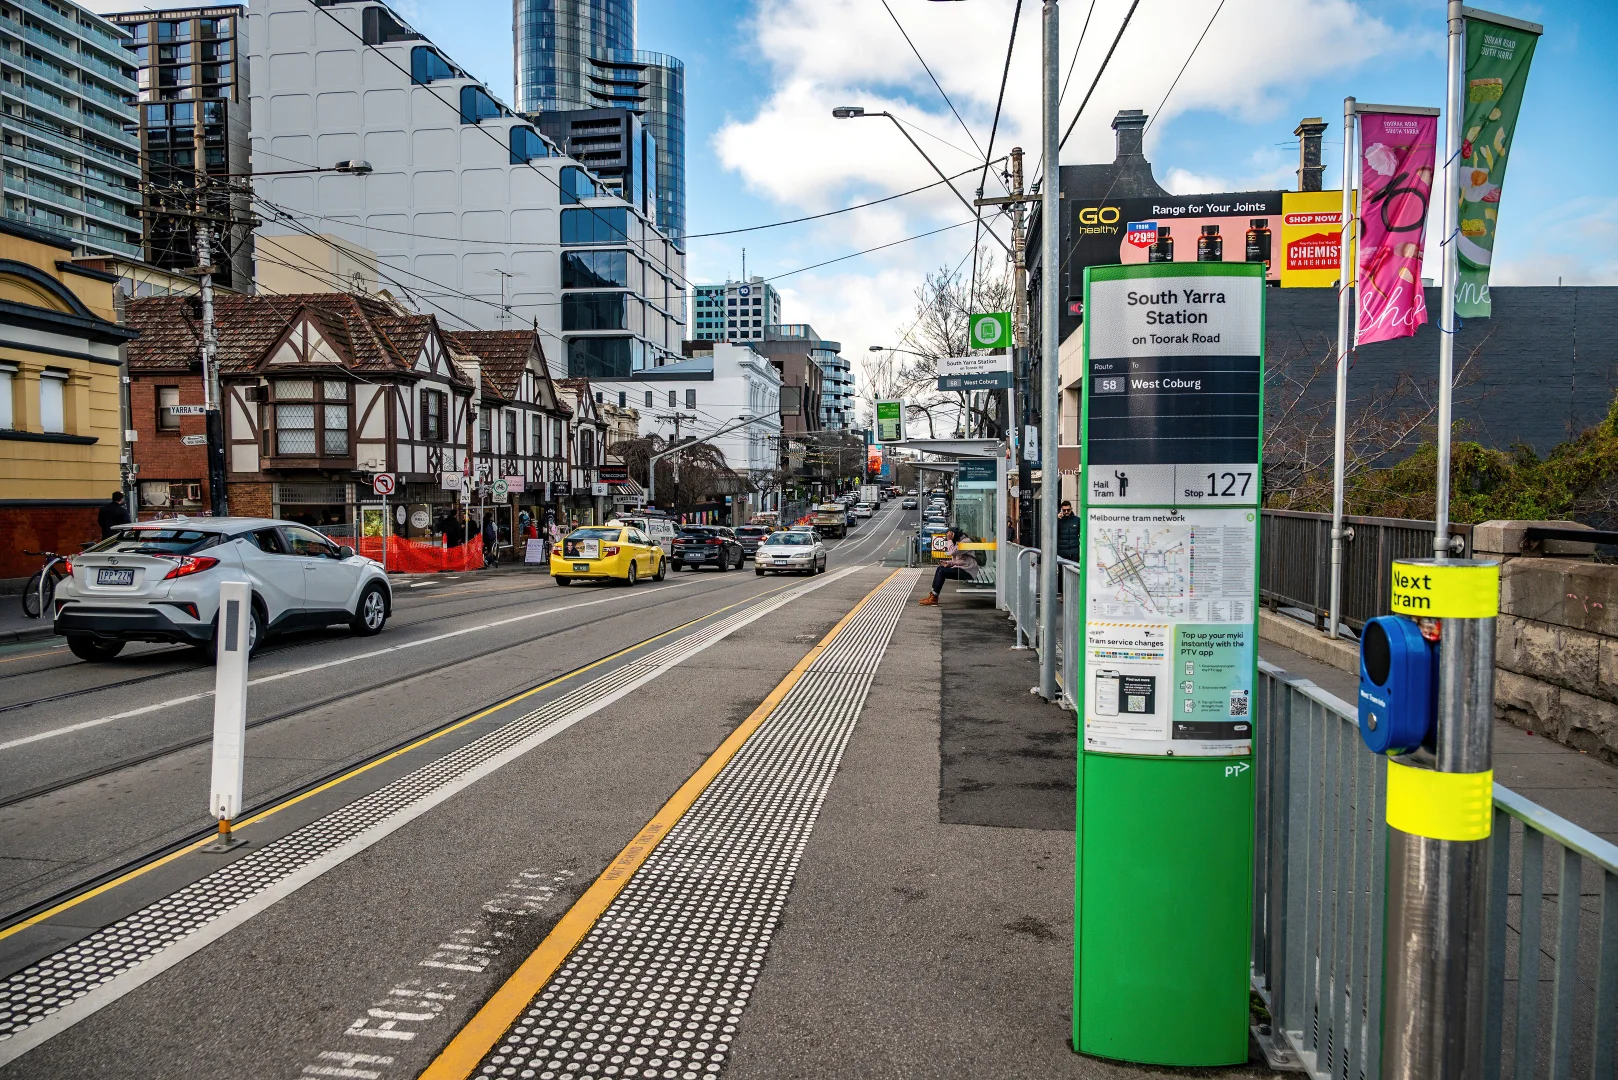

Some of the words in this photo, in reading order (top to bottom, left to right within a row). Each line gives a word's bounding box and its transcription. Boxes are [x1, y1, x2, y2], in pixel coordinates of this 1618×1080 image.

[1152, 205, 1186, 216] Range
[1188, 204, 1203, 213] for
[1205, 203, 1230, 213] Your
[1232, 202, 1266, 212] Joints
[1078, 206, 1120, 225] GO
[1079, 225, 1119, 235] healthy
[1127, 290, 1178, 306] South
[1183, 289, 1226, 304] Yarra
[1146, 310, 1208, 325] Station
[1132, 337, 1146, 345] on
[1149, 334, 1189, 345] Toorak
[1192, 333, 1220, 343] Road
[1102, 380, 1116, 390] 58
[1131, 379, 1160, 389] West
[1162, 379, 1201, 390] Coburg
[1093, 480, 1109, 489] Hail
[1184, 489, 1204, 498] Stop
[1207, 472, 1252, 497] 127
[1094, 489, 1114, 498] Tram
[1090, 514, 1130, 522] Melbourne
[1393, 570, 1432, 590] Next
[1393, 591, 1431, 609] tram
[1181, 631, 1196, 639] Top
[1134, 640, 1164, 648] changes
[1181, 640, 1214, 648] instantly
